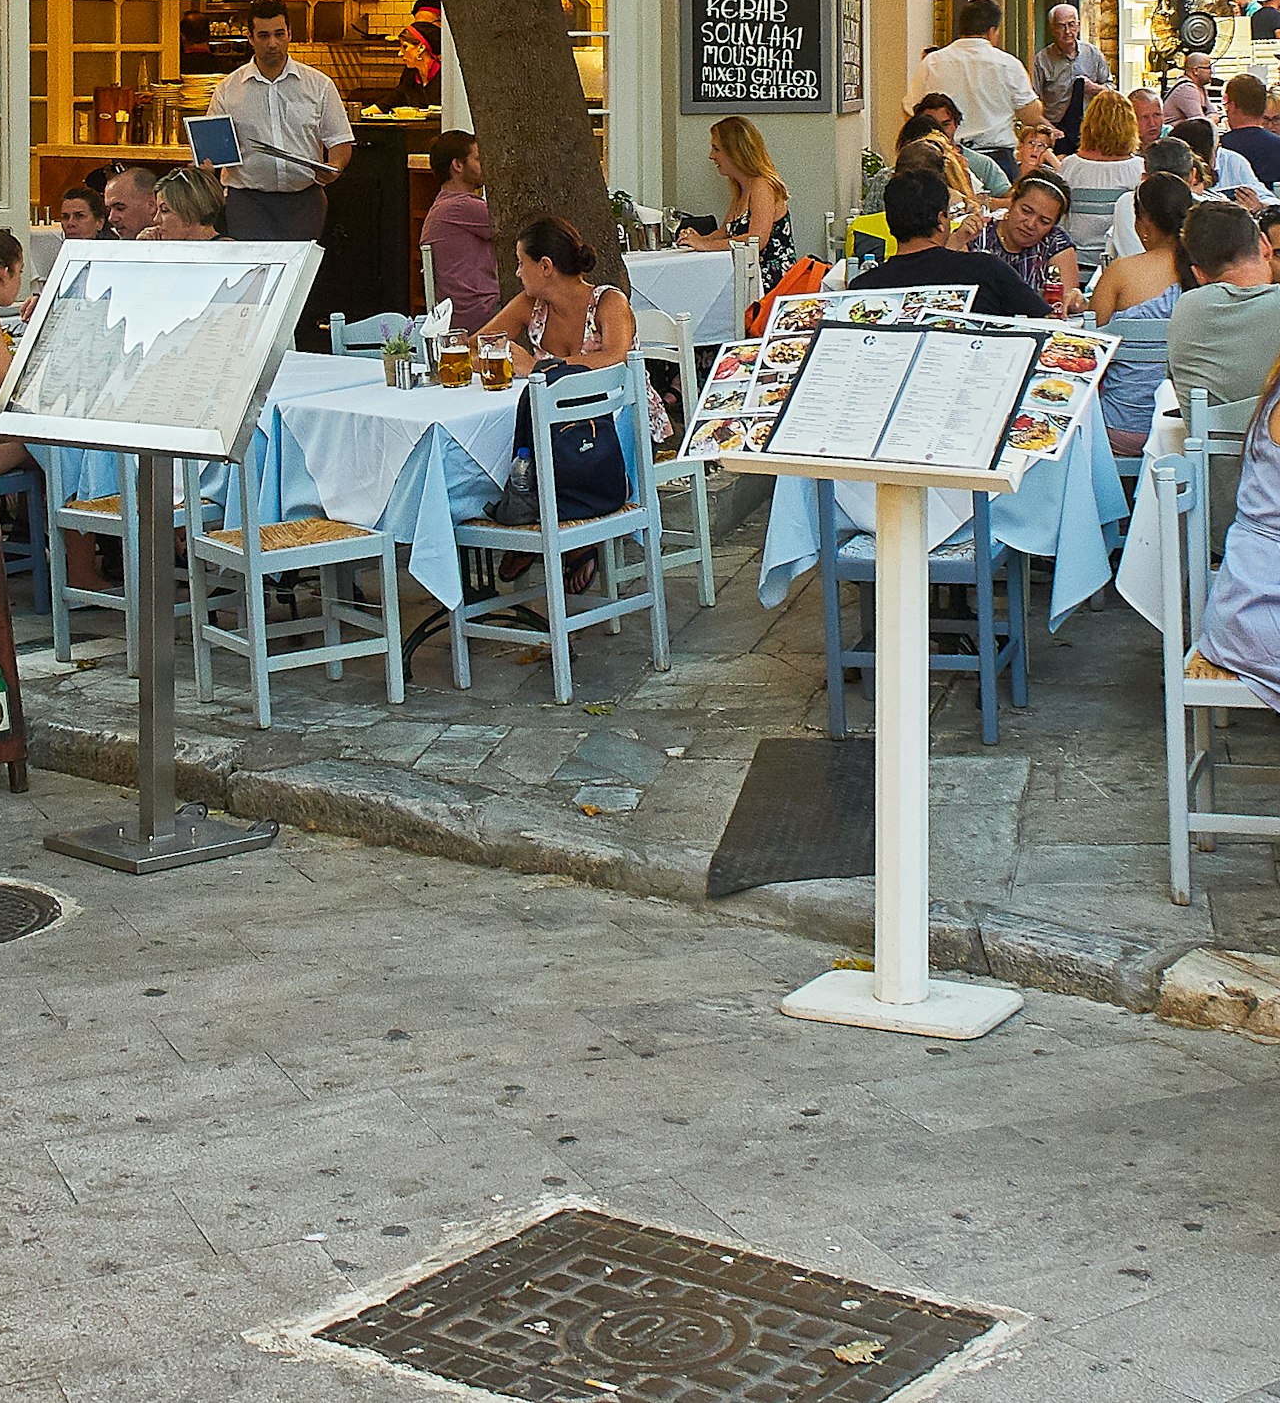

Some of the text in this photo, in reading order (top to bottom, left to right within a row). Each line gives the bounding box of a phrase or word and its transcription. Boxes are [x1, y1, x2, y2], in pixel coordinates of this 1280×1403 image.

[701, 22, 803, 49] SOUVLAKI
[703, 45, 794, 71] MOUSAKA
[702, 66, 817, 86] MIXED GRILLED
[701, 83, 747, 98] MIXED
